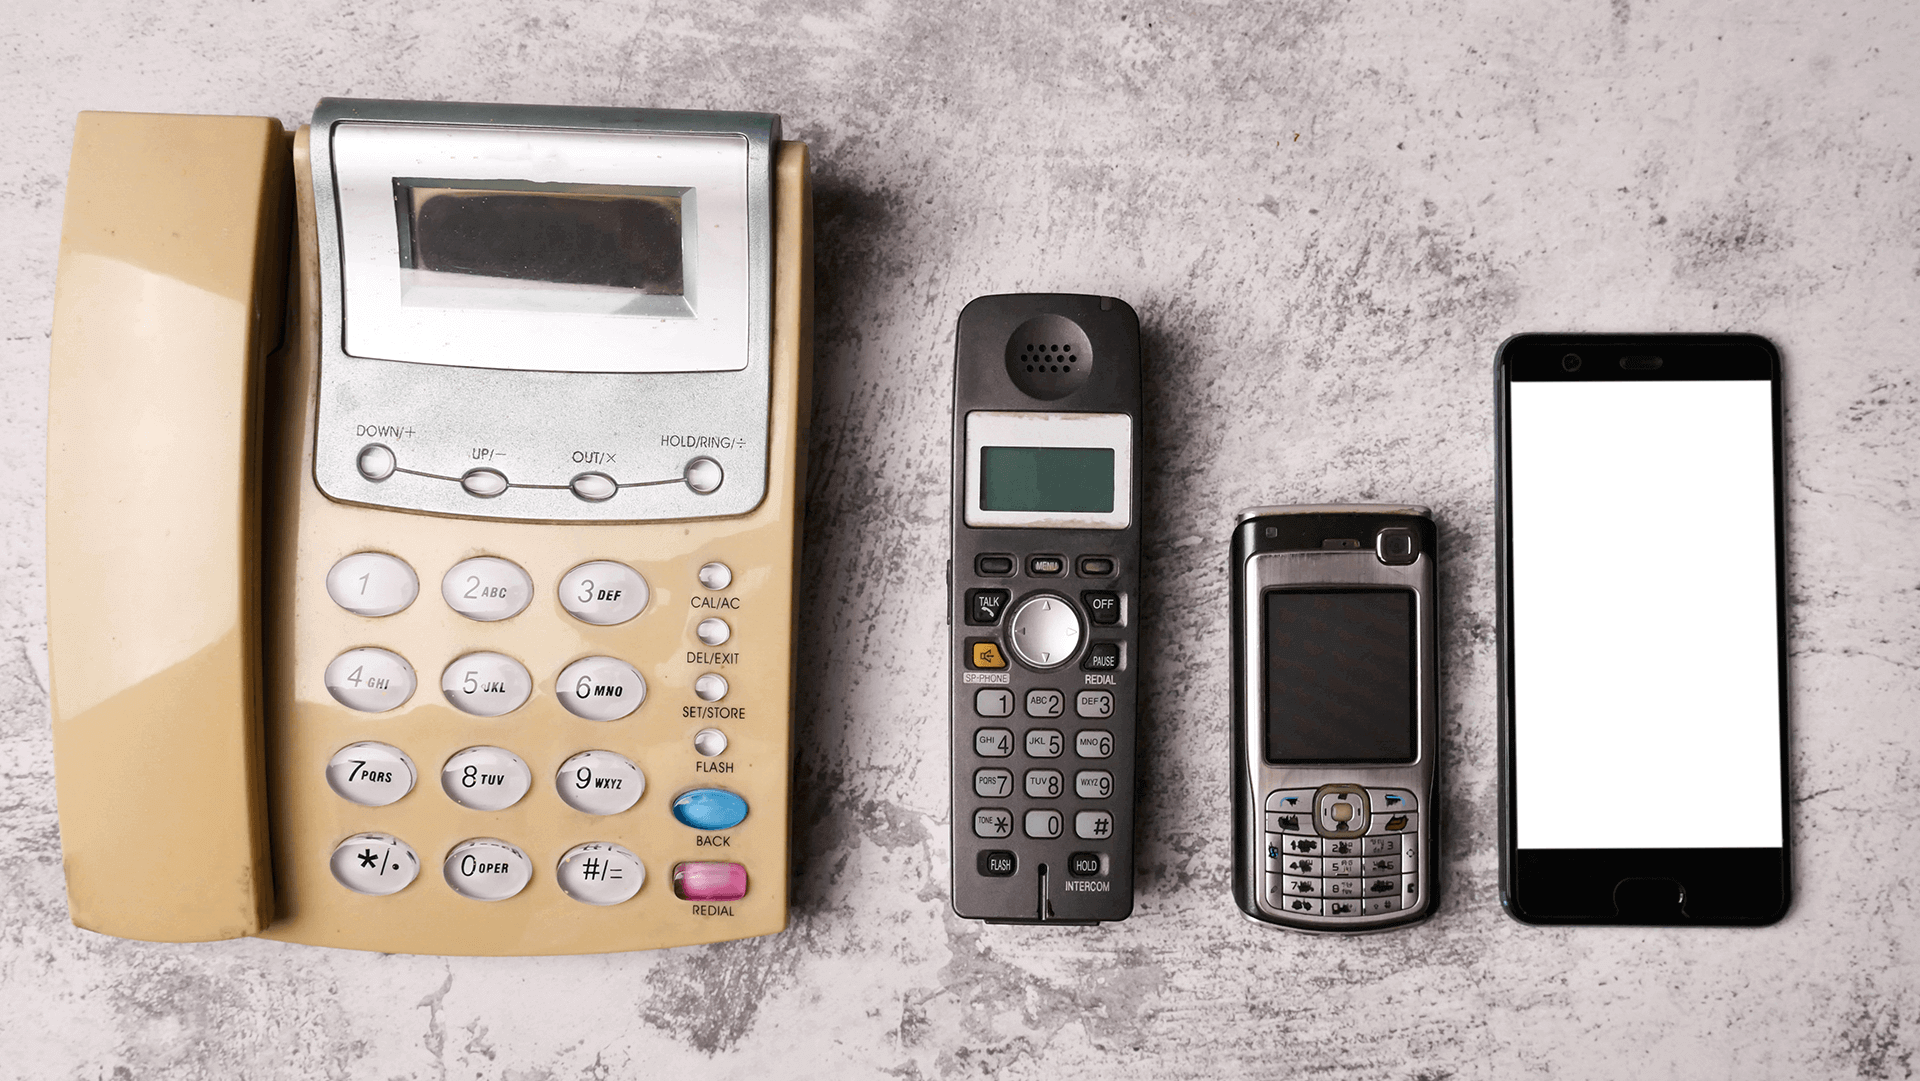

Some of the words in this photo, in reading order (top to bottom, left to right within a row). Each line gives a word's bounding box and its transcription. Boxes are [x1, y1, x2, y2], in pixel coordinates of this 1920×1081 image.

[358, 572, 371, 596] 1
[463, 575, 481, 600] 2
[481, 586, 508, 600] ABC
[577, 578, 596, 604] 3
[597, 588, 623, 602] DEF
[690, 595, 741, 610] CAL/AC
[979, 596, 1000, 608] TALK
[1092, 598, 1115, 610] OFF
[686, 651, 740, 665] DEL/EXIT
[1092, 655, 1116, 668] PAUSE
[347, 664, 364, 689] 4
[367, 676, 391, 691] GHI
[462, 670, 479, 695] 5
[482, 681, 507, 695] JKL
[575, 675, 593, 700] 6
[593, 685, 624, 698] MNO
[965, 673, 1009, 684] SP-PHONE
[1085, 673, 1117, 686] REDIAL
[682, 705, 746, 720] SET/STORE
[999, 694, 1008, 715] 1
[1030, 696, 1048, 706] ABC
[1048, 694, 1060, 715] 2
[1081, 696, 1099, 706] DEF
[1099, 695, 1111, 716] 3
[979, 735, 995, 745] GHI
[997, 734, 1010, 755] 4
[1028, 736, 1047, 746] JKL
[1049, 734, 1061, 755] 5
[1079, 737, 1099, 747] MNO
[1099, 736, 1111, 757] 6
[347, 759, 367, 783] 7
[361, 769, 393, 784] PQRS
[461, 764, 478, 789] 8
[481, 773, 506, 787] TUV
[696, 760, 734, 774] FLASH
[575, 766, 593, 790] 9
[594, 777, 624, 791] WXYZ
[978, 776, 998, 786] PQRS
[997, 775, 1009, 796] 7
[1029, 776, 1048, 786] TUV
[1048, 775, 1060, 796] 8
[1080, 777, 1099, 787] WXYZ
[1099, 776, 1111, 797] 9
[978, 815, 994, 825] TONE
[1048, 815, 1060, 836] 0
[1093, 817, 1110, 836] #
[696, 835, 731, 848] BACK
[1387, 841, 1394, 851] 3
[461, 854, 477, 878] 0
[478, 862, 510, 876] OPER
[990, 858, 1012, 871] FLASH
[1076, 859, 1098, 872] HOLD
[1332, 863, 1339, 872] 5
[1065, 880, 1111, 893] INTERCOM
[1332, 883, 1340, 893] 8
[692, 904, 735, 917] REDIAL
